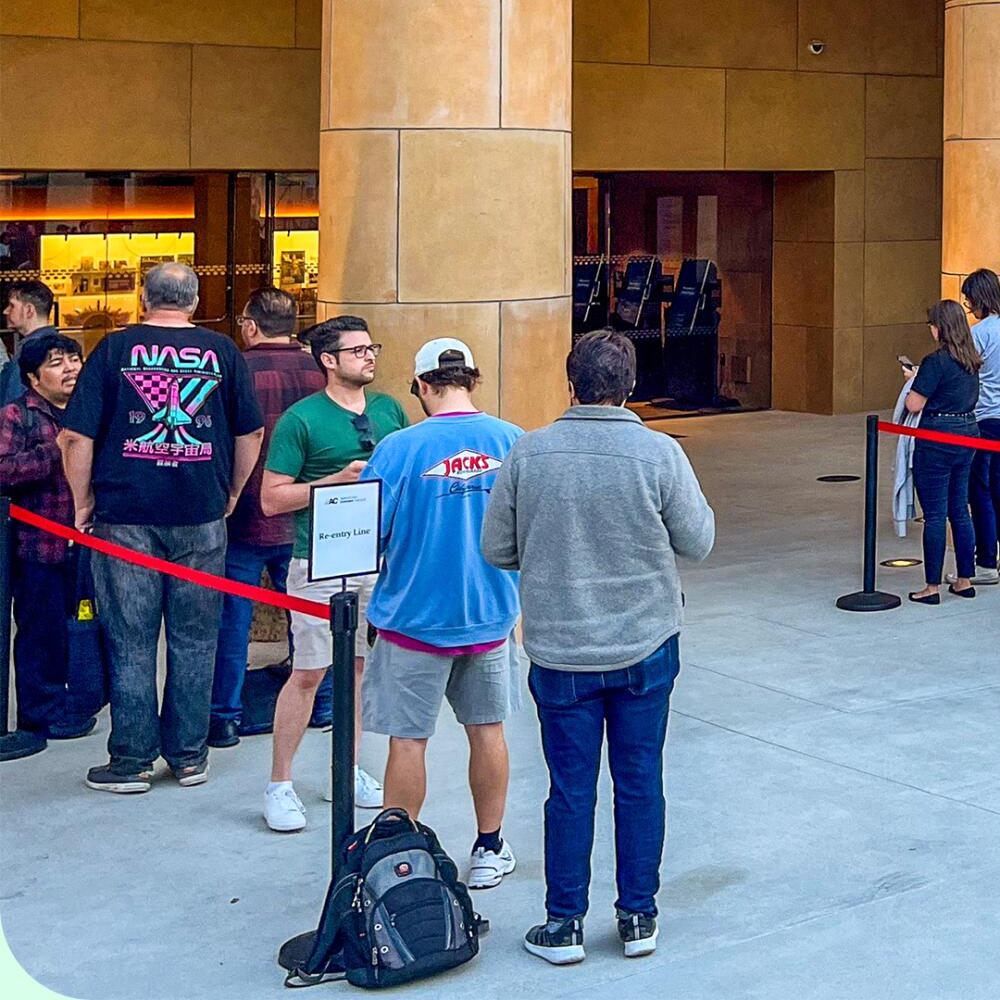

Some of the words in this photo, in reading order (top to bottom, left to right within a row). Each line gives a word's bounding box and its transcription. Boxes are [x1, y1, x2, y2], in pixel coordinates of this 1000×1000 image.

[131, 344, 220, 373] NASA
[128, 410, 146, 424] 19
[319, 530, 352, 541] Re-entry
[353, 528, 371, 537] Line
